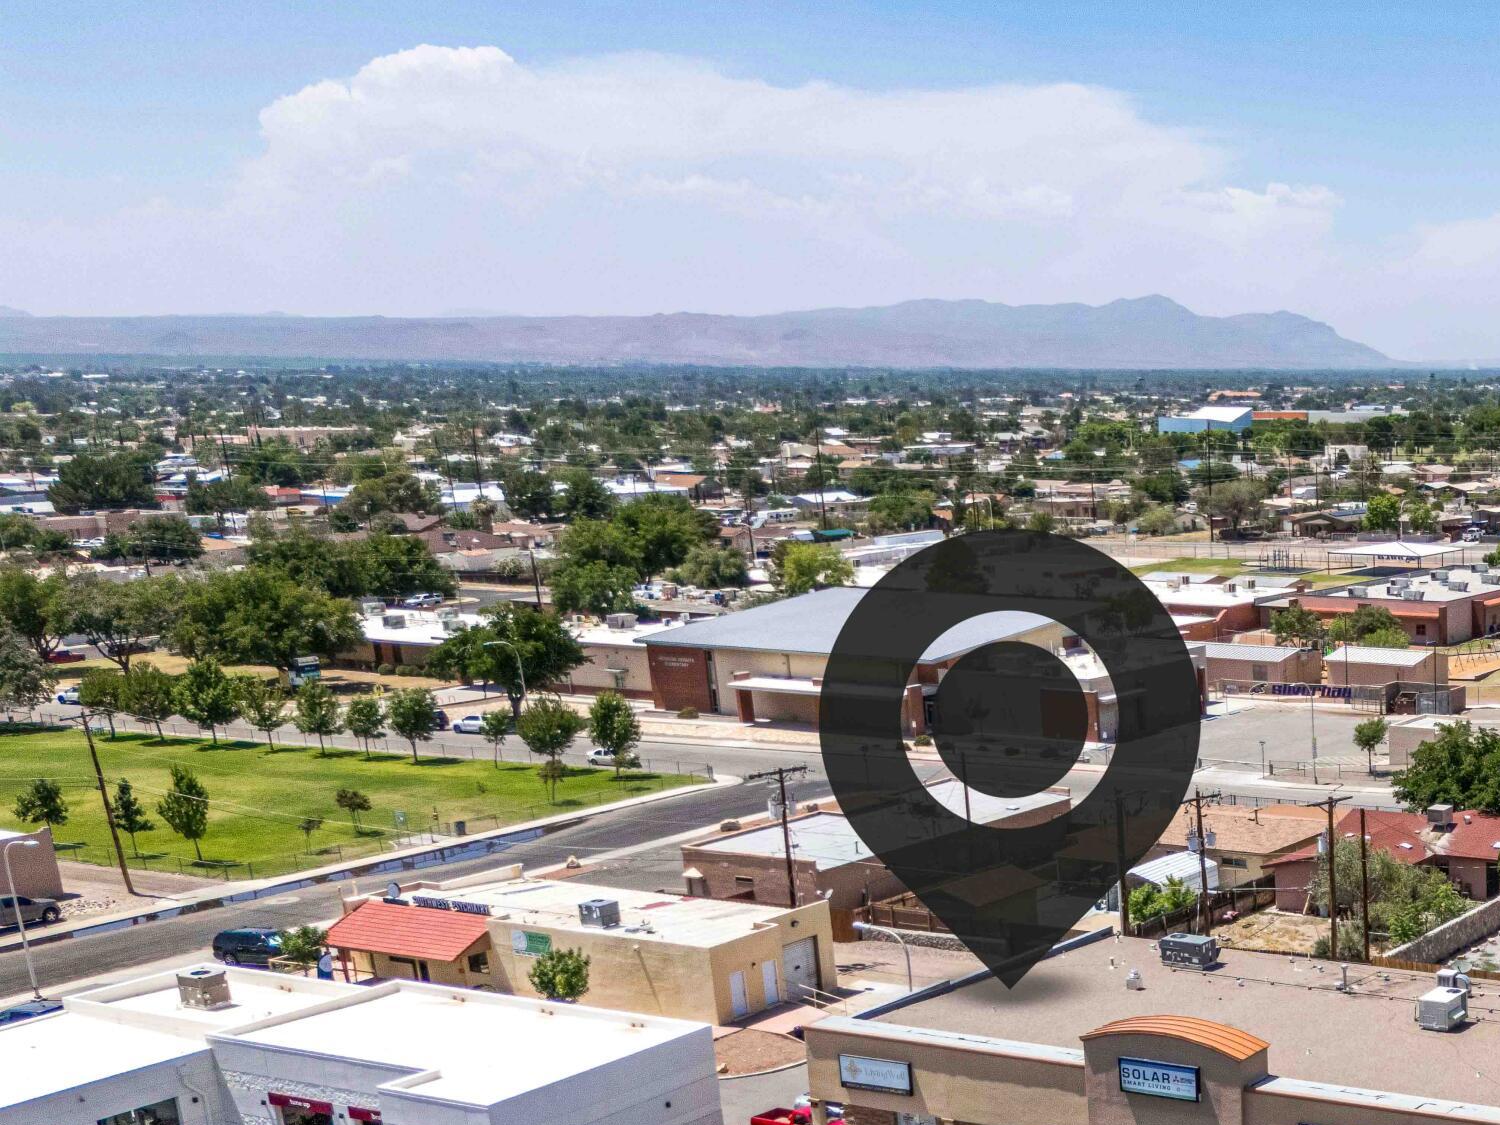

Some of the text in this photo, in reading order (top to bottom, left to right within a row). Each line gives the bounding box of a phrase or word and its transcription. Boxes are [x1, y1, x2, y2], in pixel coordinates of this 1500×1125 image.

[412, 895, 490, 916] SOUTHWEST PSYCHIATRY
[1122, 1067, 1171, 1084] SOLAR
[1122, 1080, 1146, 1088] SMART
[1148, 1083, 1171, 1091] LIVING
